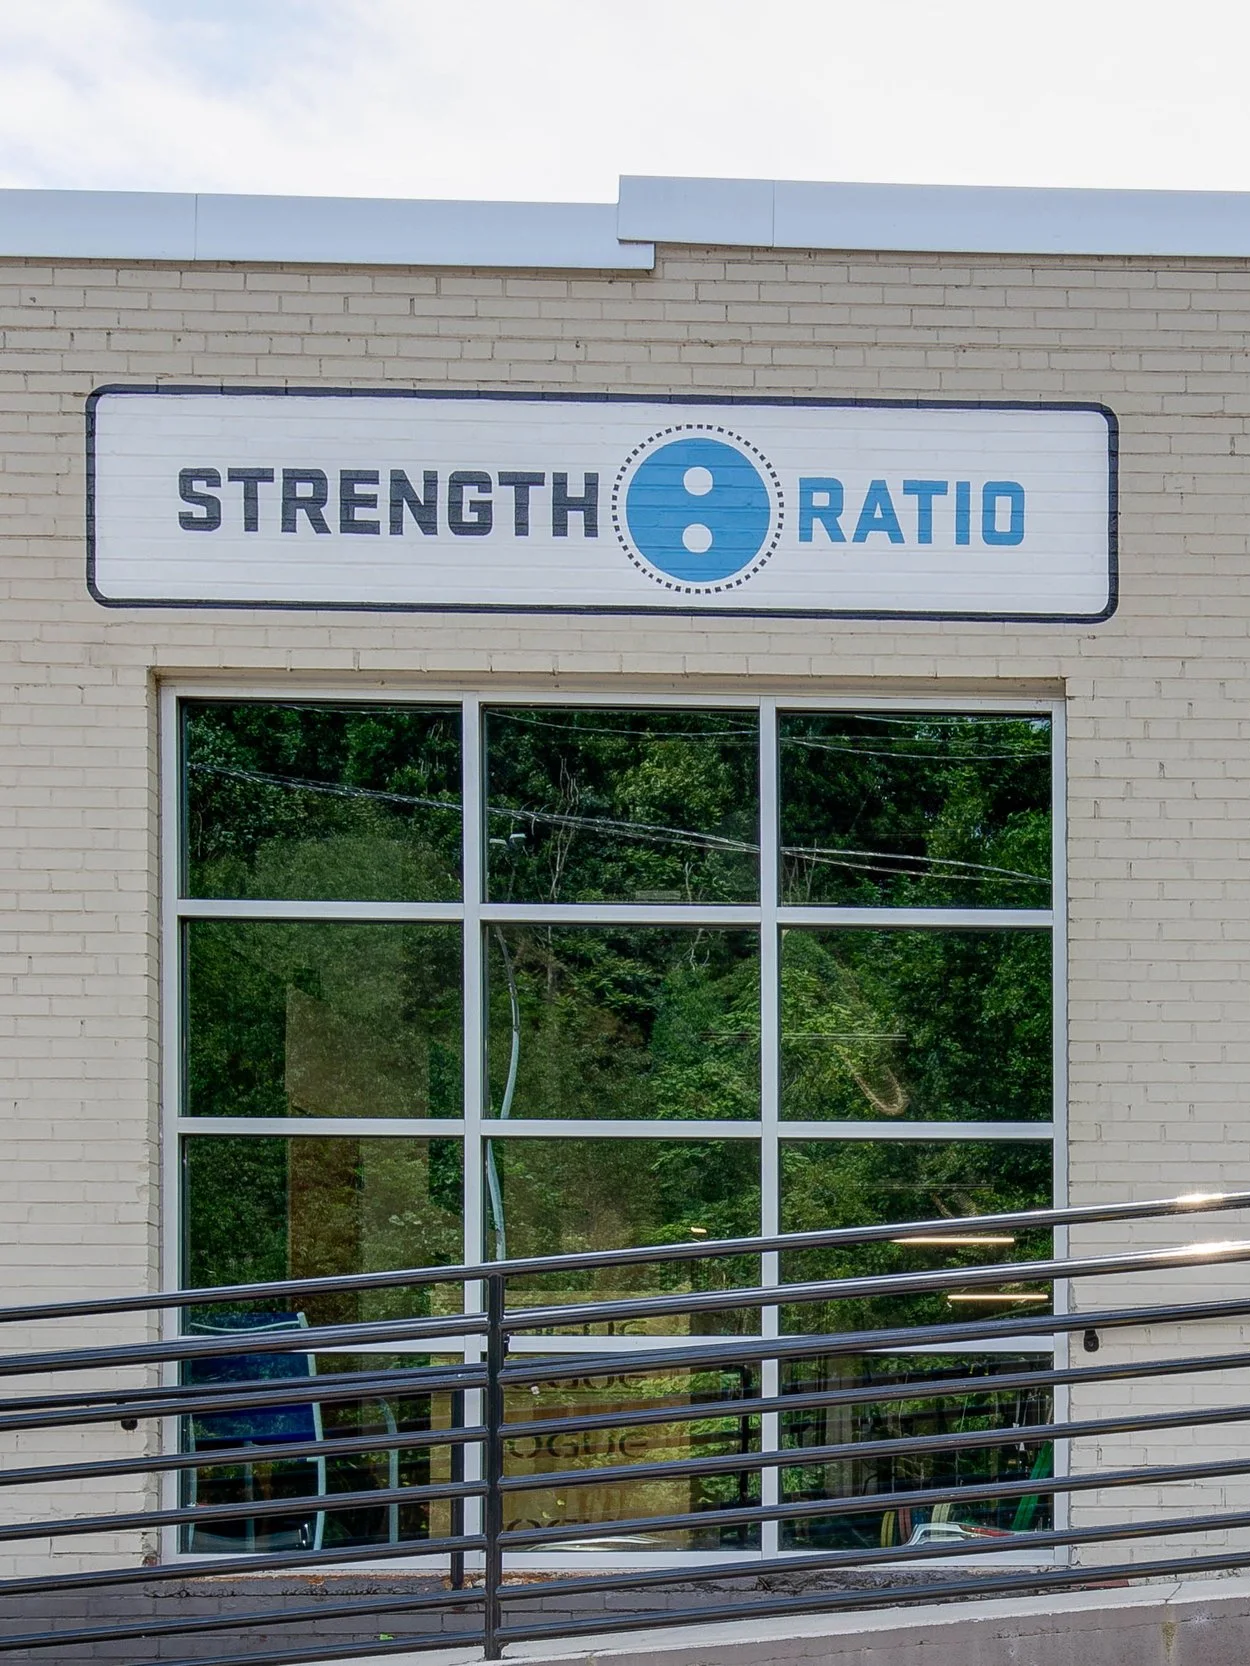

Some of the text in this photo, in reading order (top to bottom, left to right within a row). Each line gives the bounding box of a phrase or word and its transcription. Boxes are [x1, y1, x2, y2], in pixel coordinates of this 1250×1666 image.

[178, 467, 1025, 546] STRENGTH RATIO
[506, 1432, 648, 1458] OGUE
